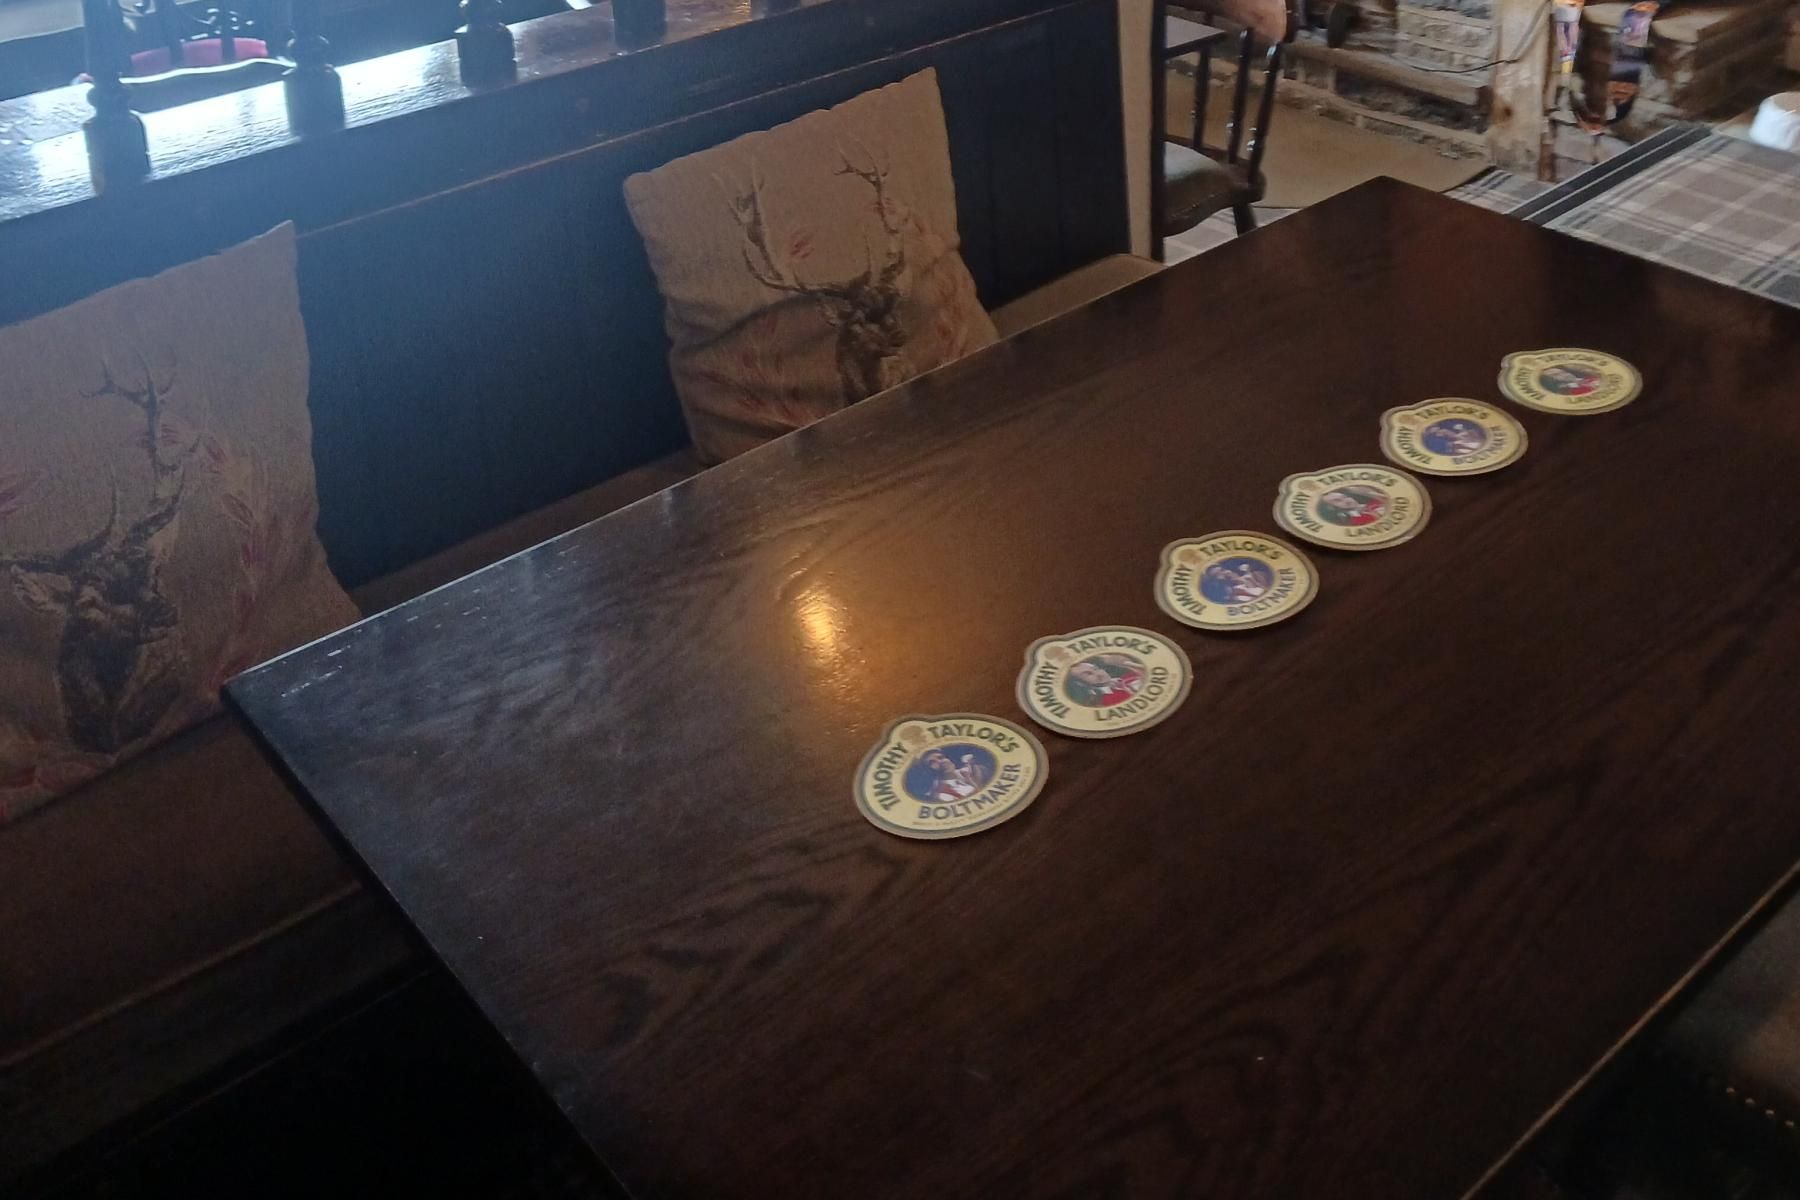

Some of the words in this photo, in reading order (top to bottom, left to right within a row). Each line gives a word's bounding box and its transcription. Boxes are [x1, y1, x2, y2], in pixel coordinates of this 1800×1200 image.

[1172, 564, 1207, 616] TIMOTHY
[1226, 567, 1297, 616] BOLTMAKER
[1034, 661, 1071, 719] TIMOTHY
[1067, 636, 1158, 656] TAYLOR'S
[1095, 666, 1169, 721] LANDLORD
[873, 741, 909, 811] TIMOTHY
[928, 724, 1020, 753] TAYLOR'S
[918, 763, 1022, 820] BOLTMAKER
